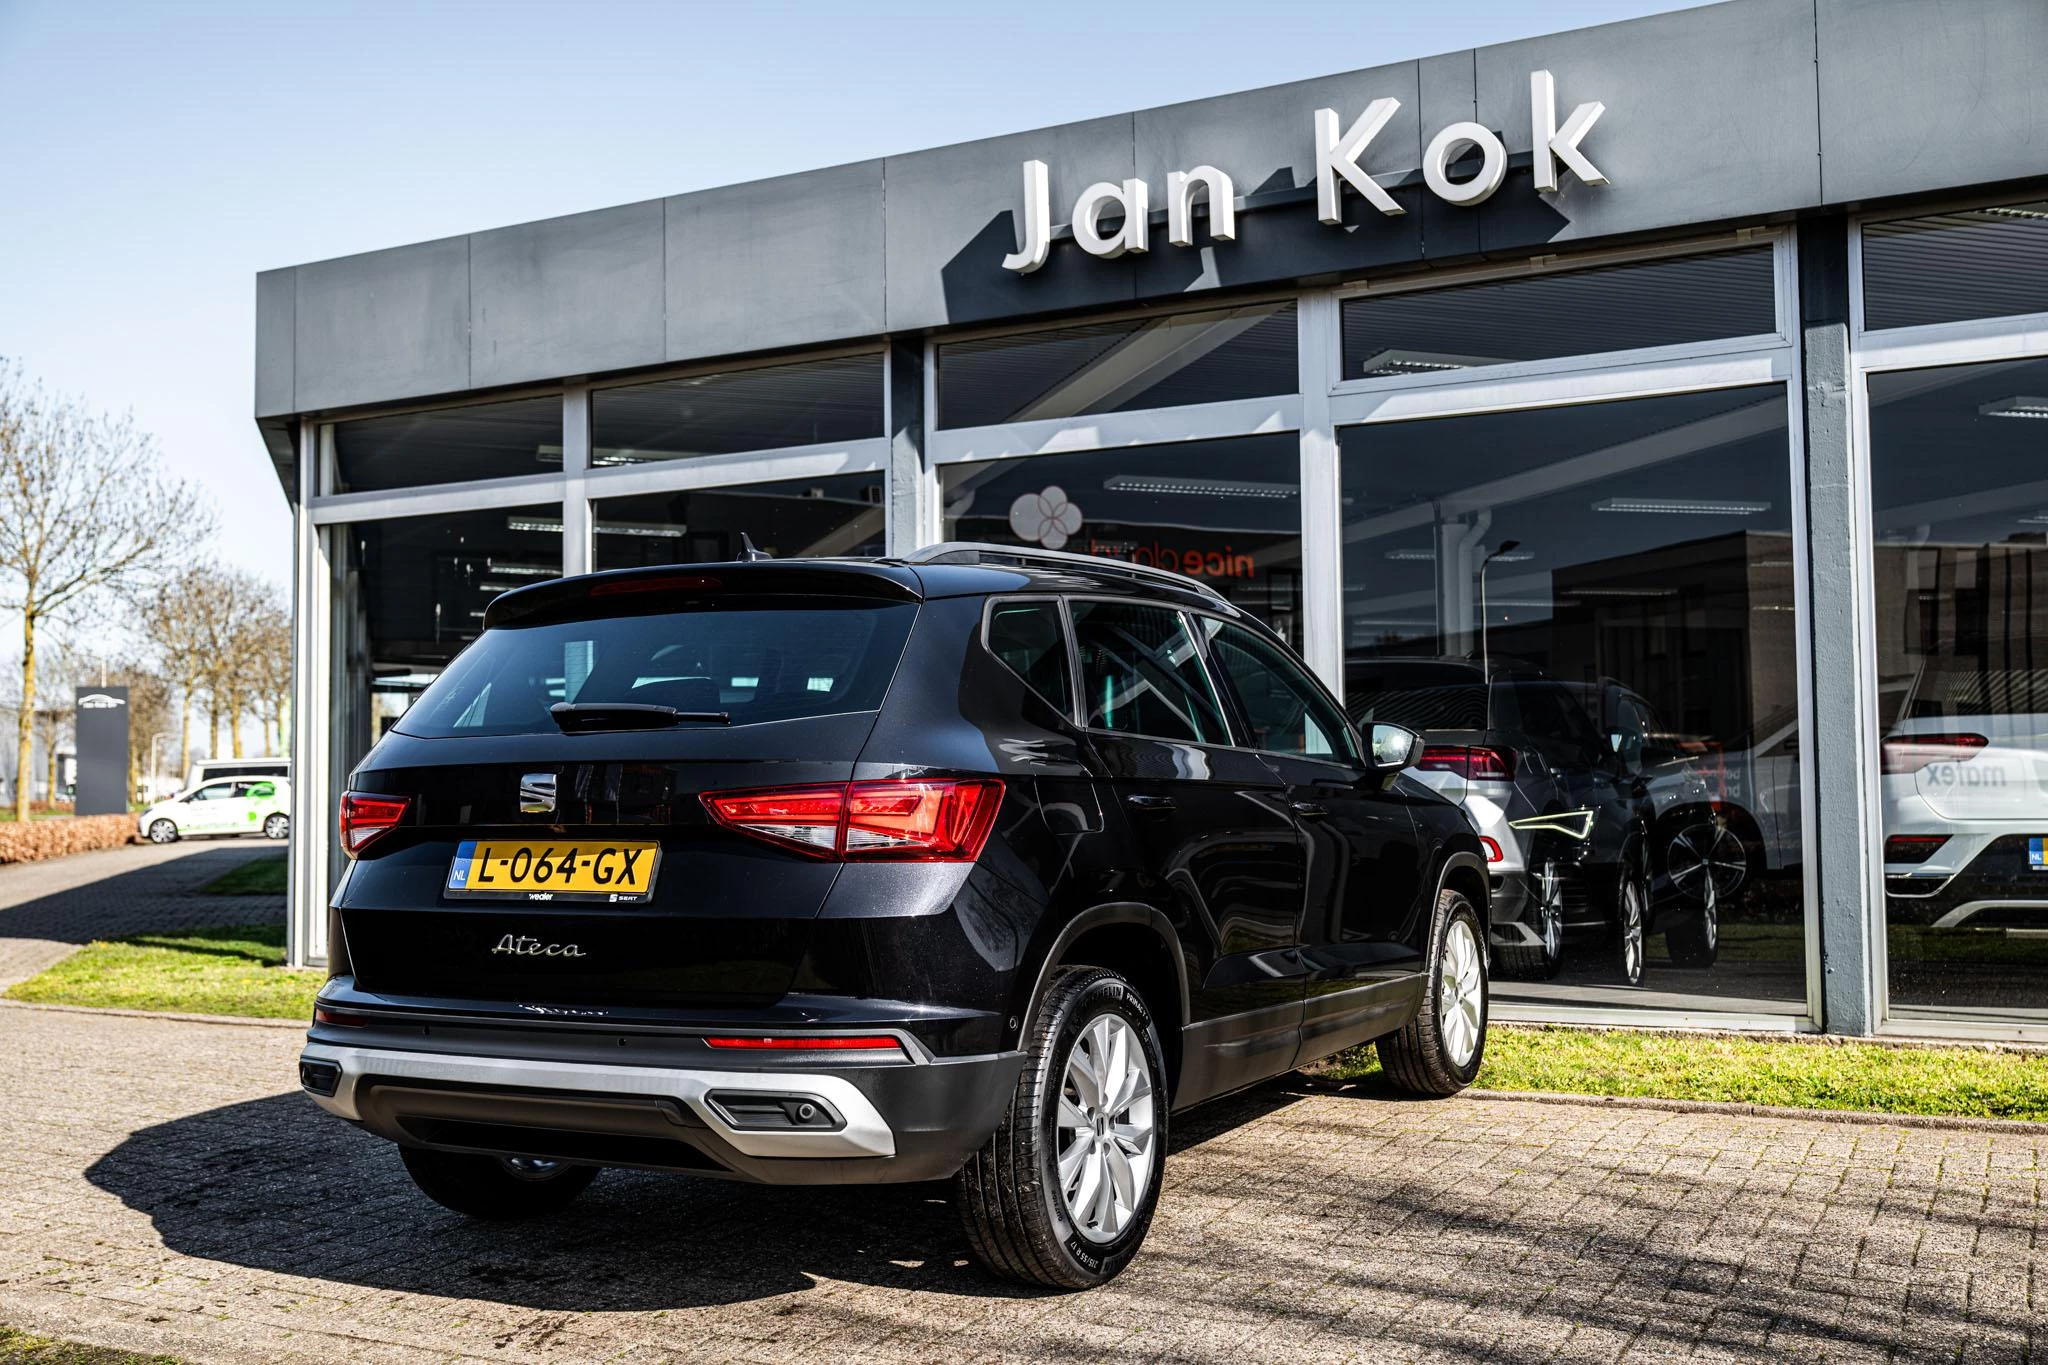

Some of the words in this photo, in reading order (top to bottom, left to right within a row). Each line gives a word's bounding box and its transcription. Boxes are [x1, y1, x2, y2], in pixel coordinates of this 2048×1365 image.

[1002, 159, 1236, 274] Jan
[1313, 69, 1610, 225] Kok
[453, 869, 466, 881] NL
[477, 847, 643, 885] L-064-GX
[491, 933, 587, 957] Ateca
